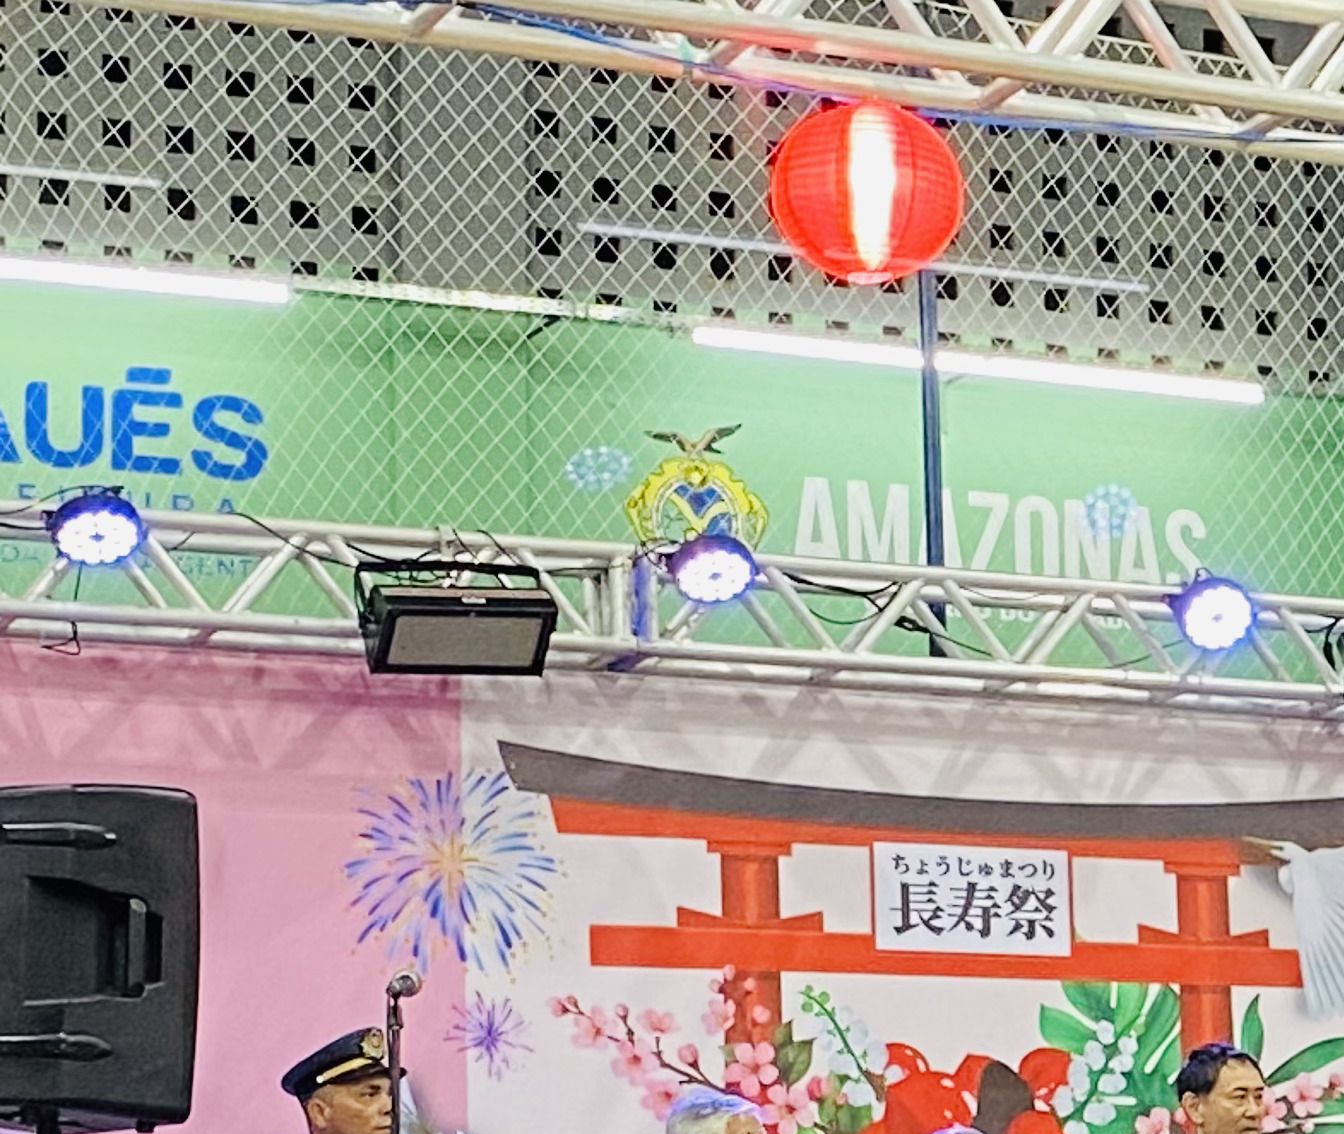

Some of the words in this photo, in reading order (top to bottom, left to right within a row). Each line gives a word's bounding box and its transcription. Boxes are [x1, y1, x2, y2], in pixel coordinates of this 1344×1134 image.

[892, 853, 1056, 881] ちょうじゅまつり
[889, 881, 1058, 940] 長寿祭
